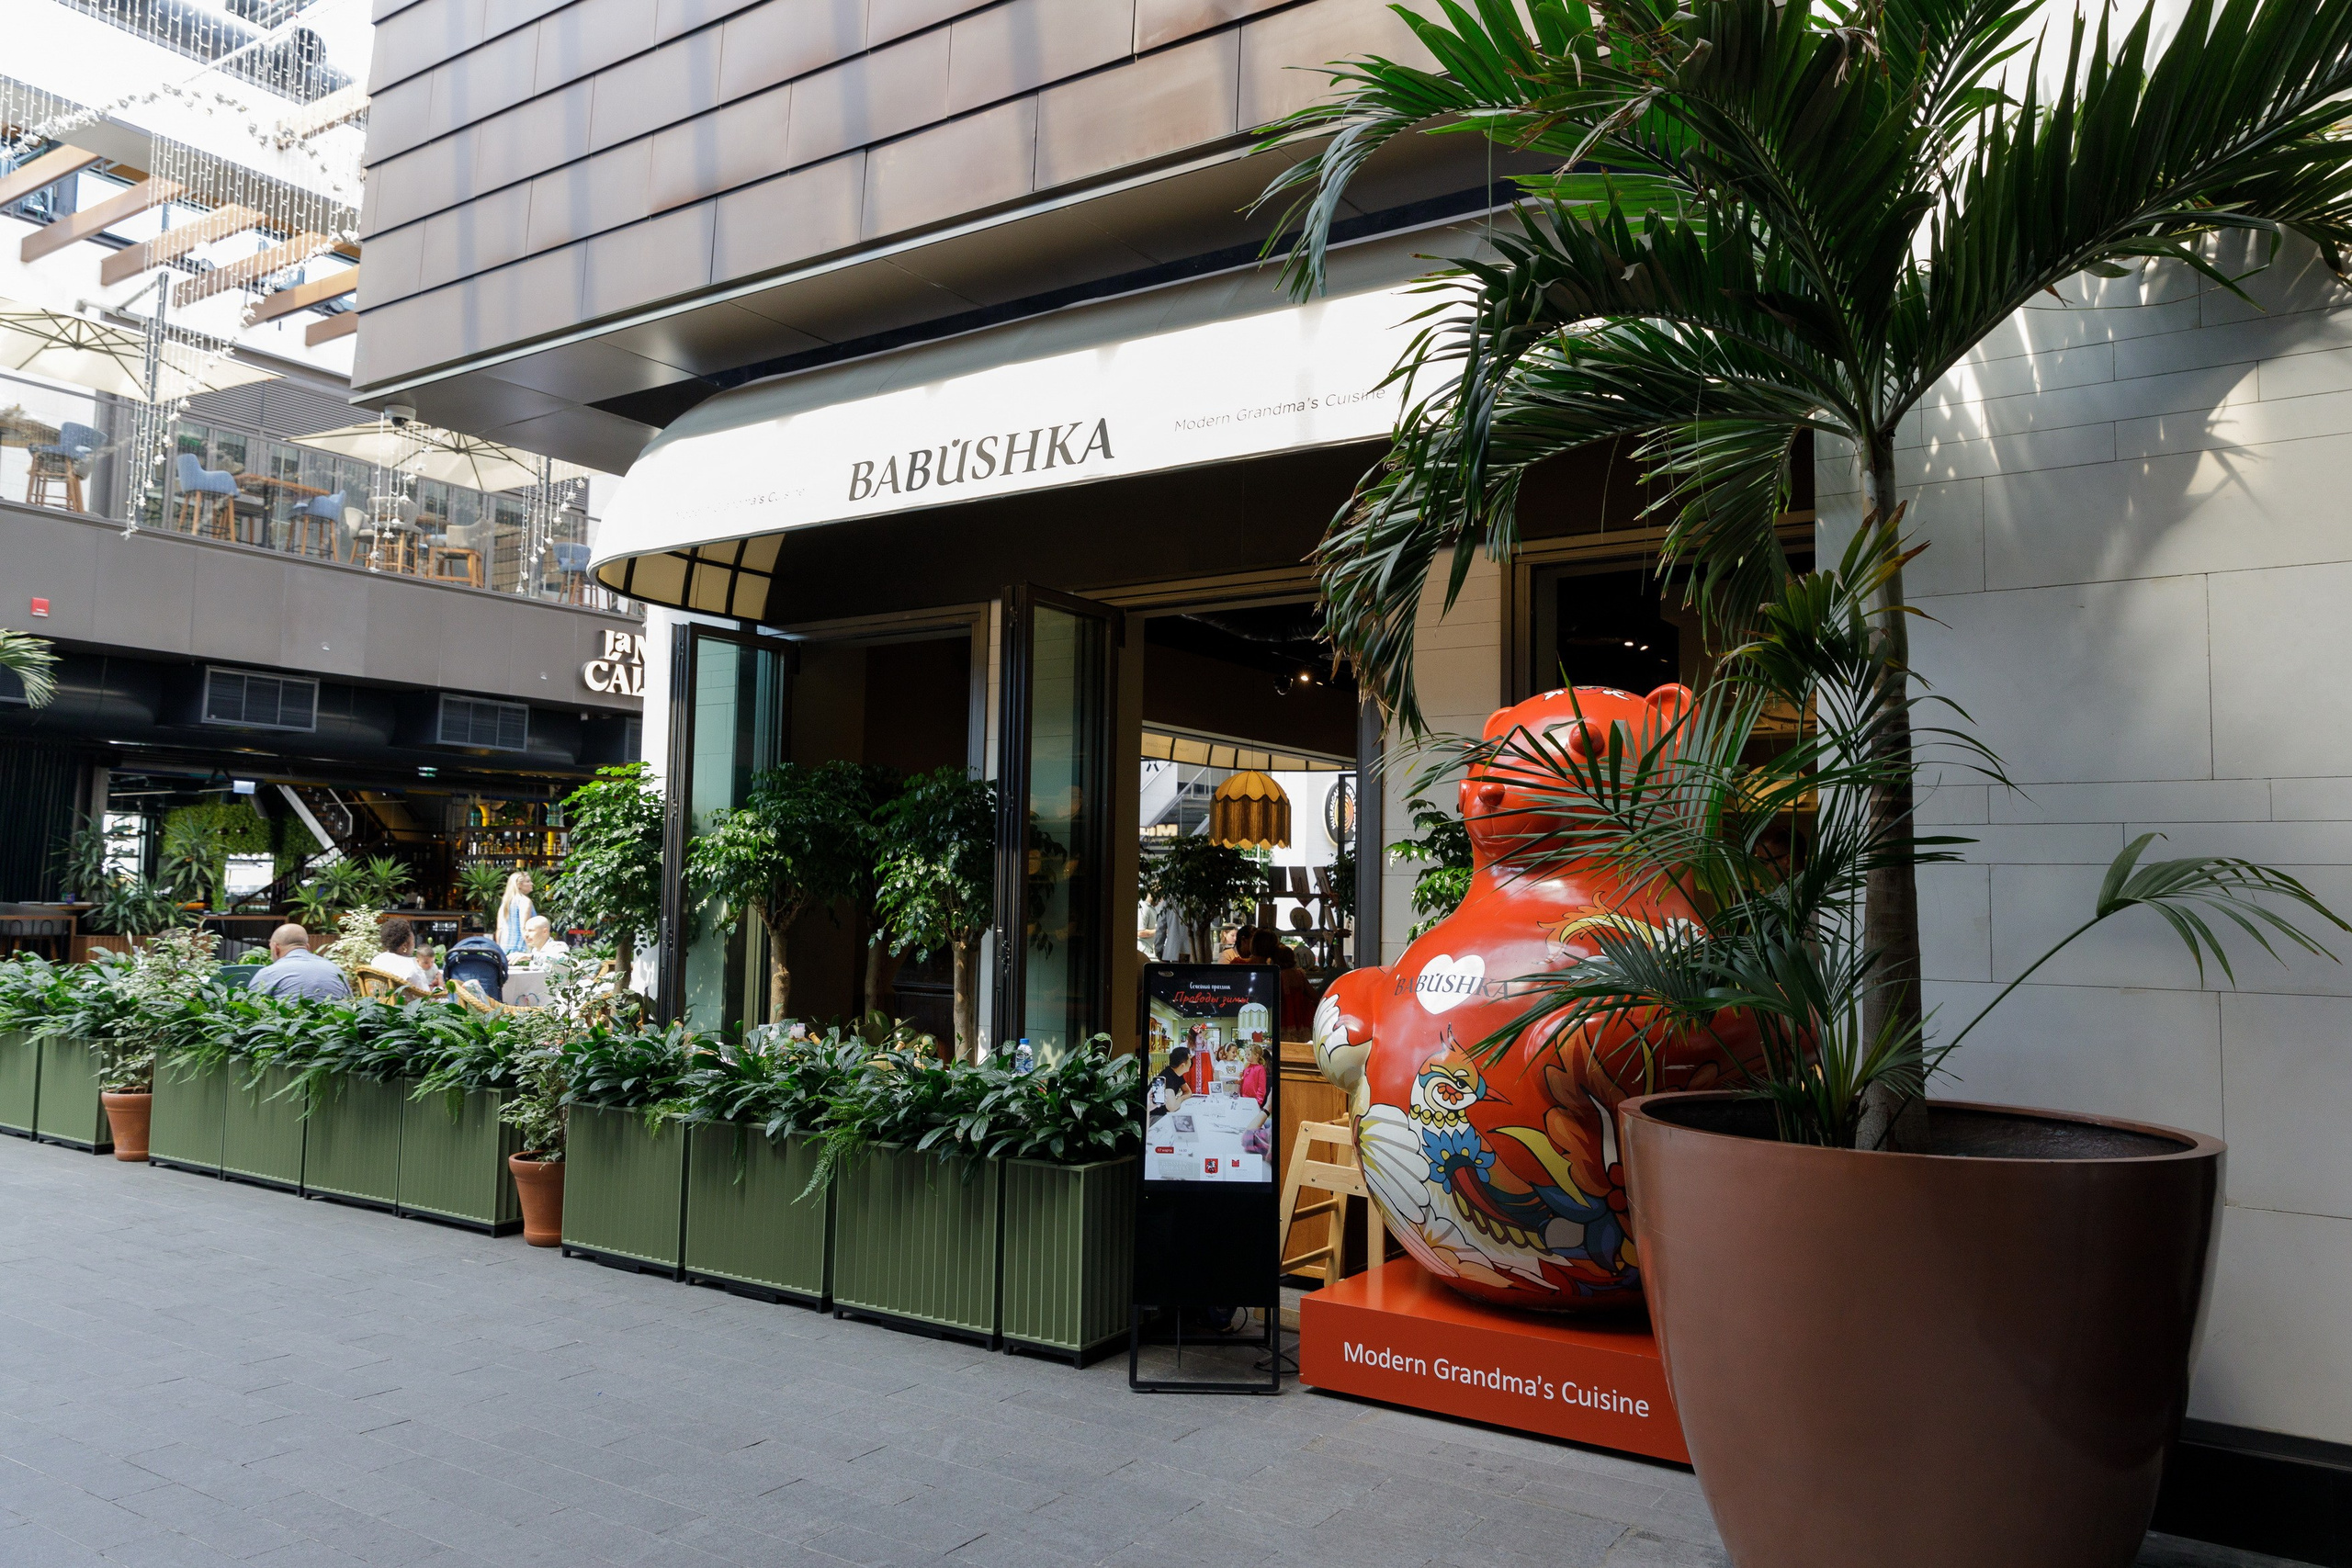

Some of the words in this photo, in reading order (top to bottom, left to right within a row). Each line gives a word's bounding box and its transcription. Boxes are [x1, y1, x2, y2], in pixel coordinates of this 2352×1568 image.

[1173, 413, 1230, 433] Modern
[1237, 397, 1319, 423] Grandma's
[1325, 388, 1386, 408] Cuisine
[1173, 991, 1219, 1006] Проводы
[1219, 995, 1250, 1008] зимы
[1343, 1341, 1427, 1376] Modern
[1433, 1358, 1555, 1400] Grandma's
[1561, 1381, 1650, 1418] Cuisine
